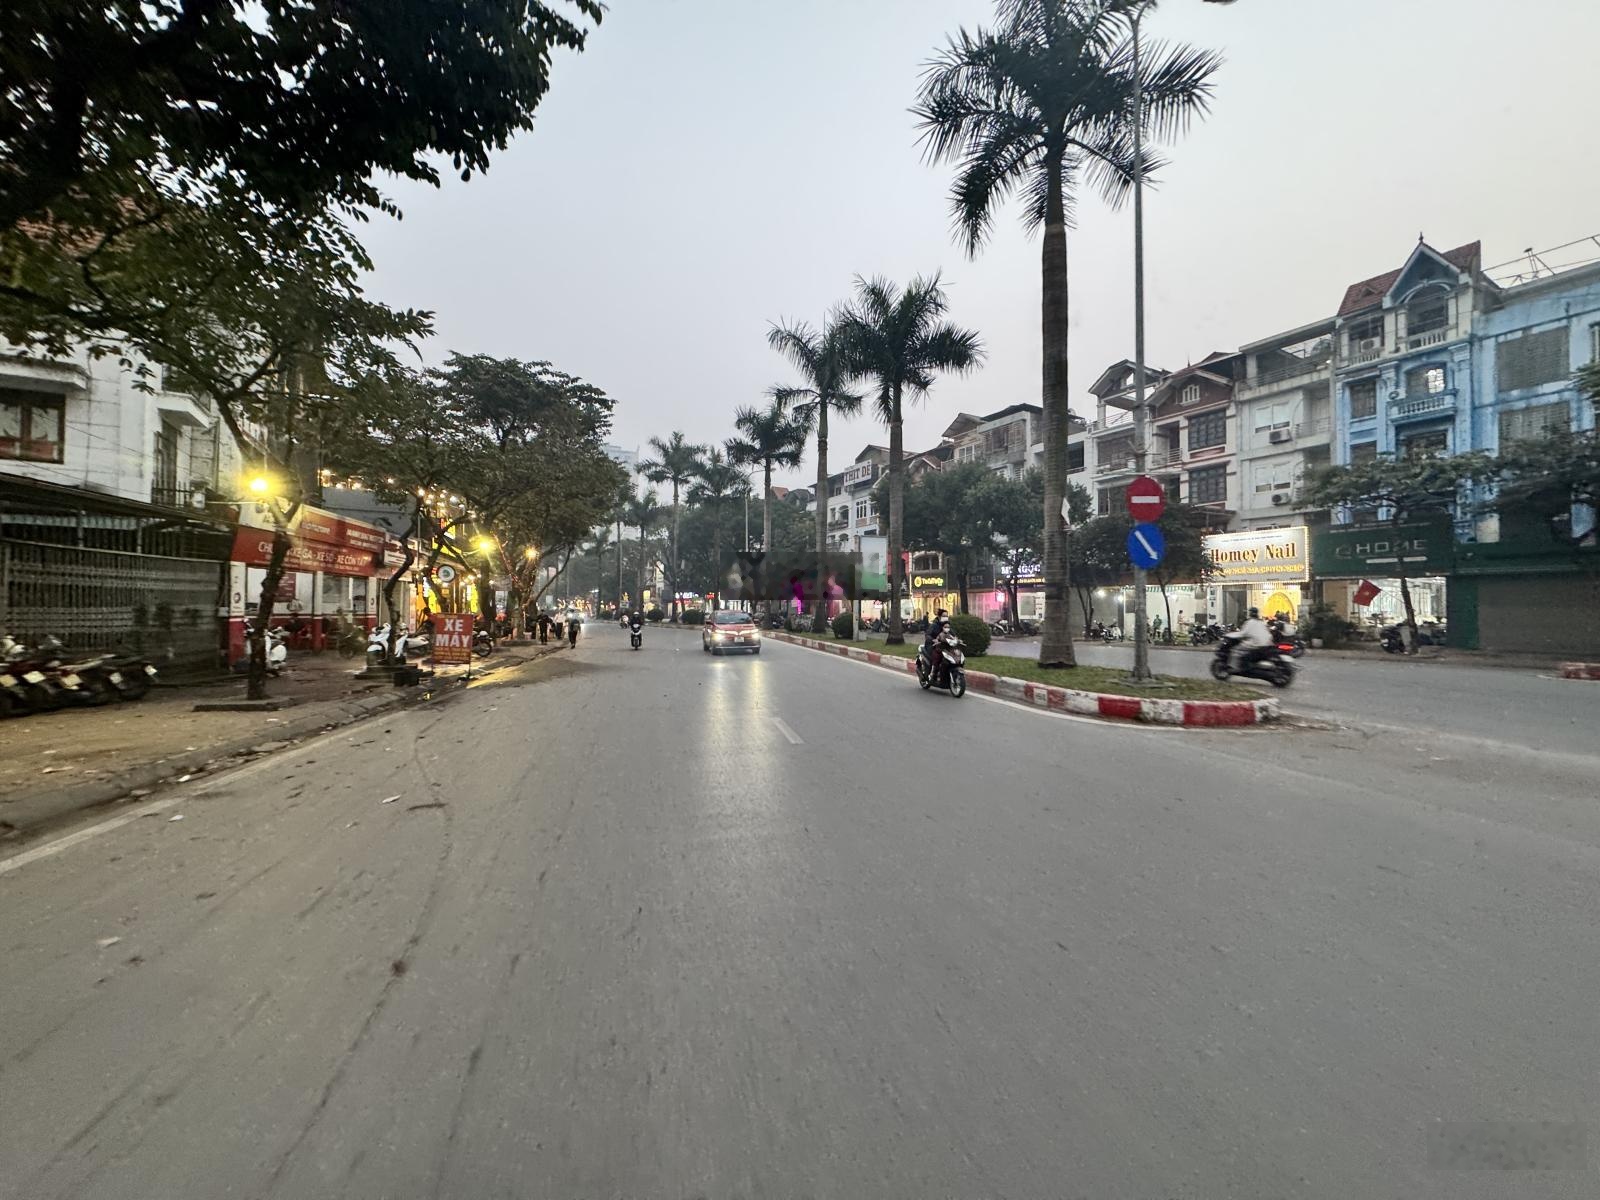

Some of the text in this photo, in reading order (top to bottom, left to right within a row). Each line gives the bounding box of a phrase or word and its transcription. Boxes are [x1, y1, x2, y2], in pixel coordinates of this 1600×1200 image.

[1265, 542, 1297, 560] Nail
[444, 619, 464, 631] XE
[436, 631, 470, 648] MÁY
